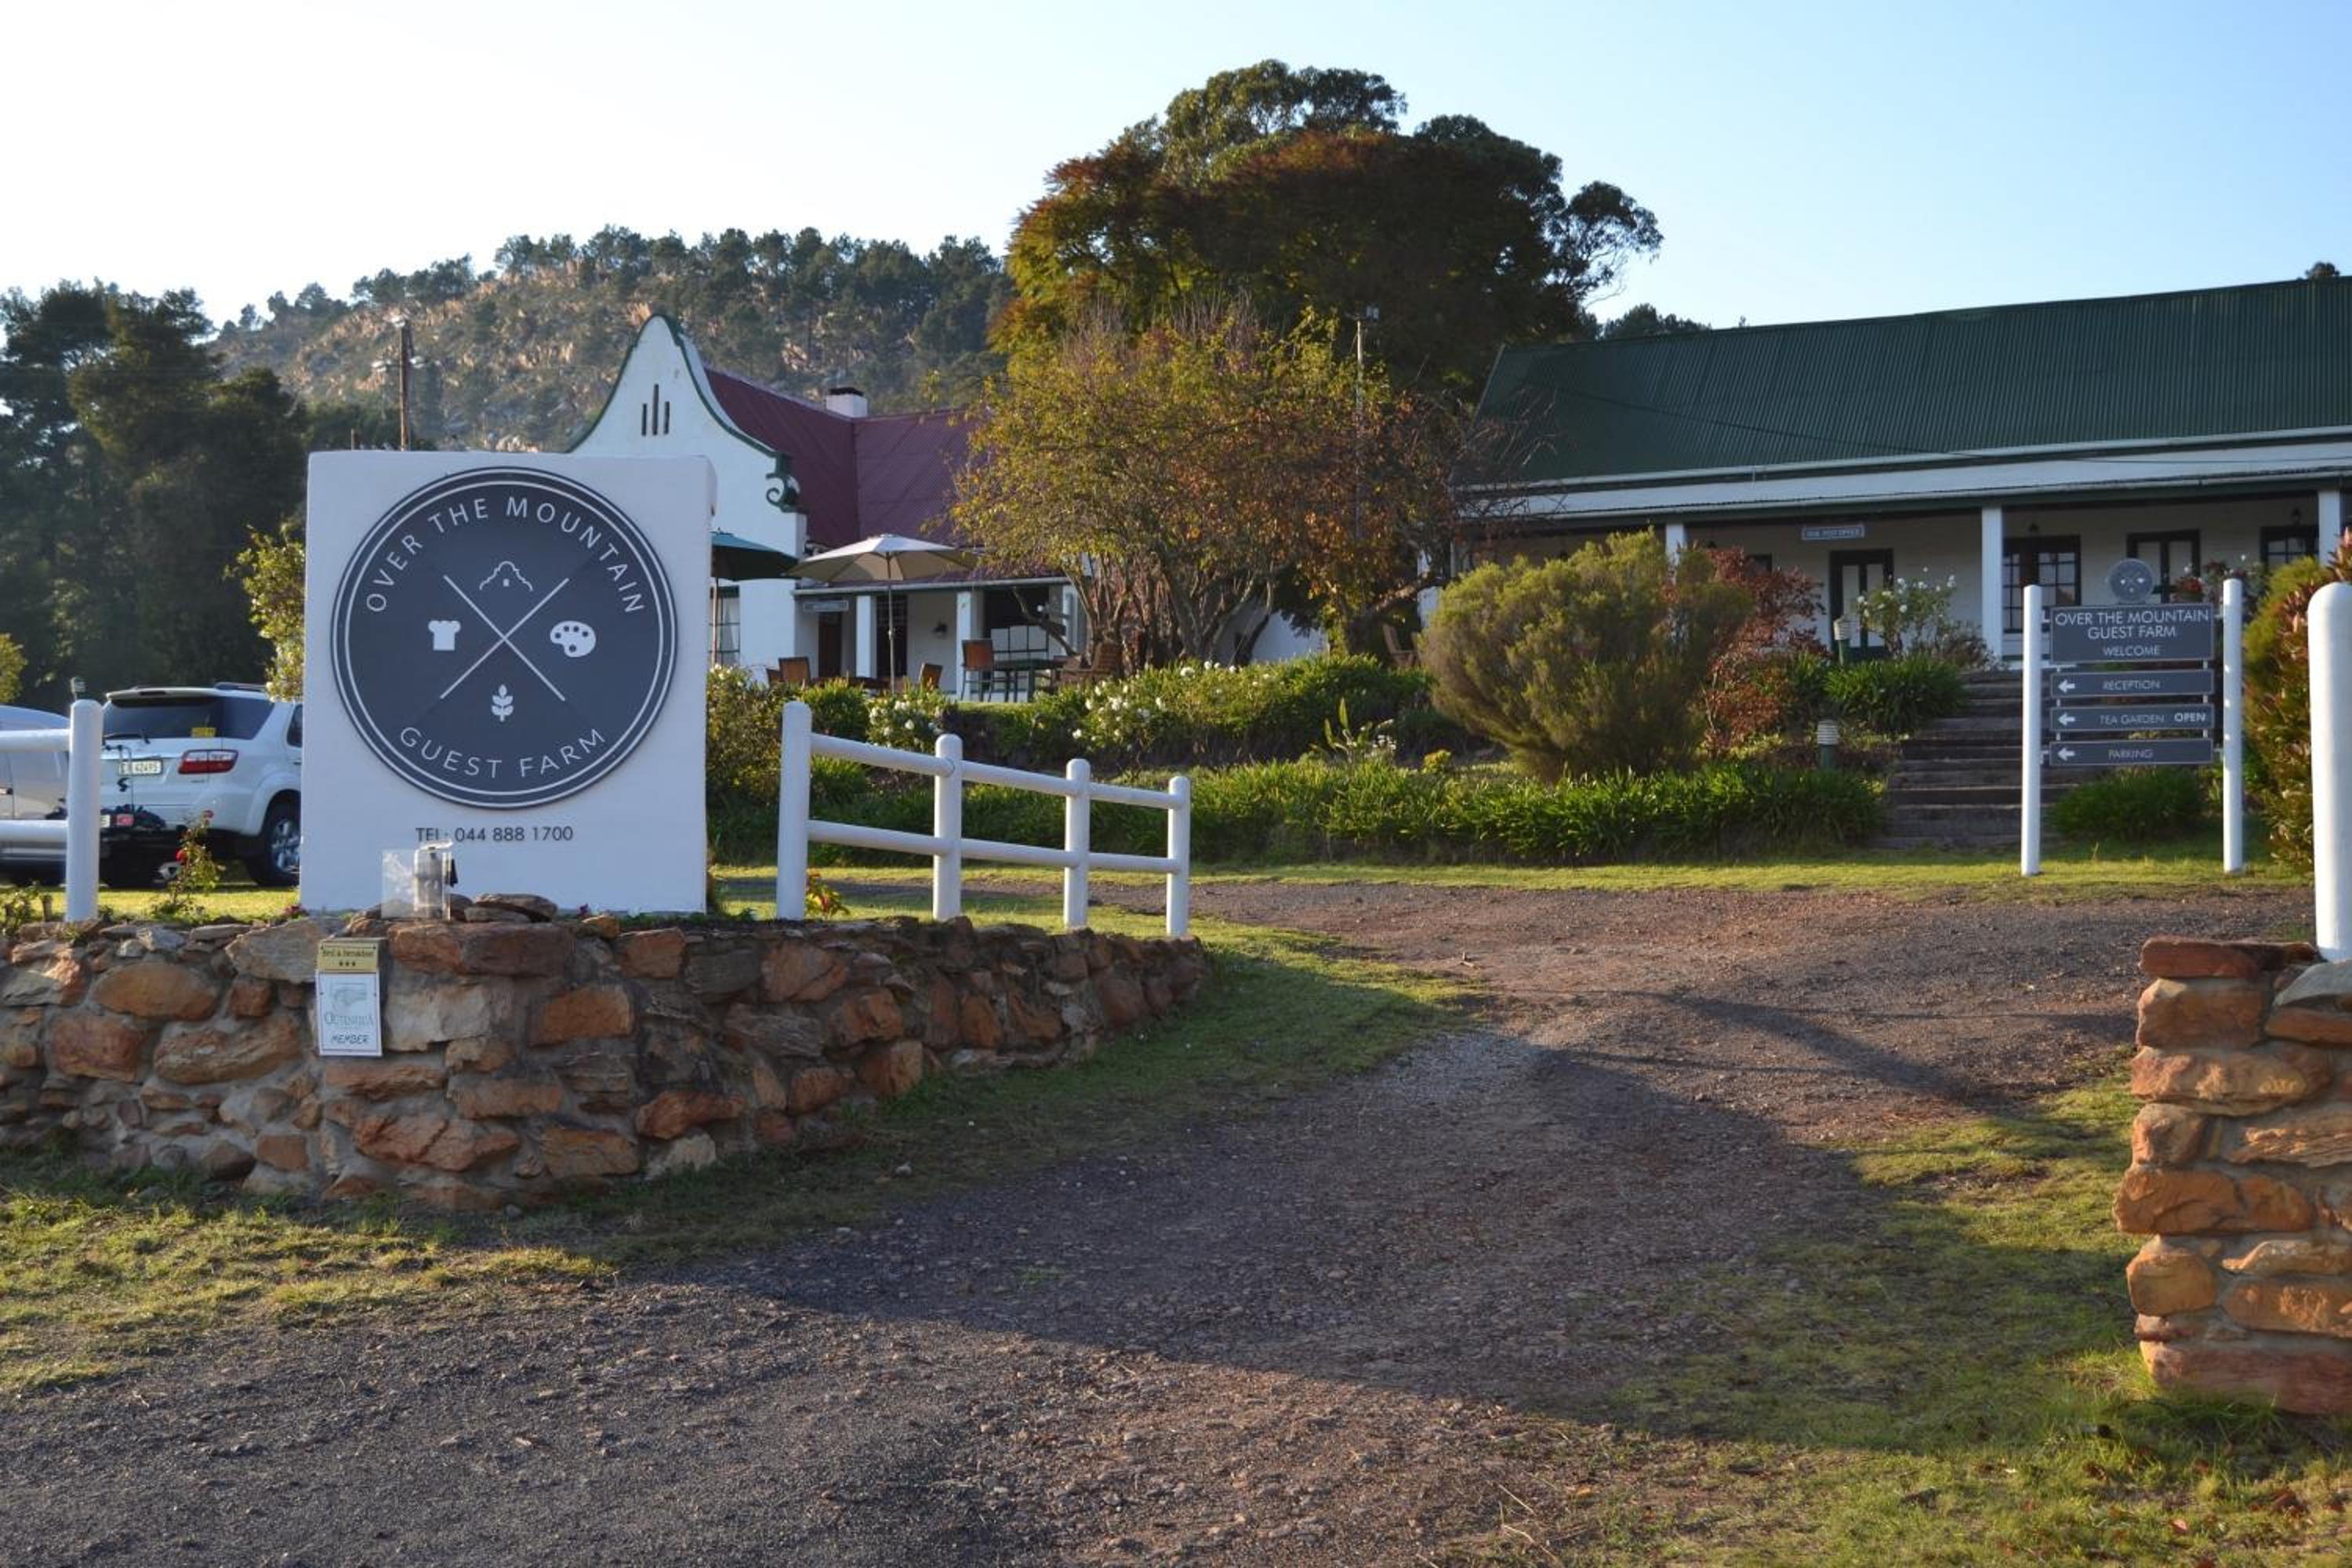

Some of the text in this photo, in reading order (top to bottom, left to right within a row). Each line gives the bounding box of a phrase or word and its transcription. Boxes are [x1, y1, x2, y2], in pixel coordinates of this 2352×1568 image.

[366, 495, 645, 614] OVER THE MOUNTAIN
[2055, 609, 2209, 626] OVER THE MOUNTAIN
[2087, 625, 2176, 640] GUEST FARM
[2102, 644, 2161, 656] WELCOME
[2102, 680, 2161, 691] RECEPTION
[2100, 712, 2207, 724] TEA GARDEN OPEN
[401, 727, 605, 779] GUEST FARM
[2108, 749, 2154, 759] PARKING
[455, 827, 486, 842] 044
[492, 826, 525, 842] 888
[533, 826, 574, 841] 1700
[332, 1034, 370, 1045] MEMBER
